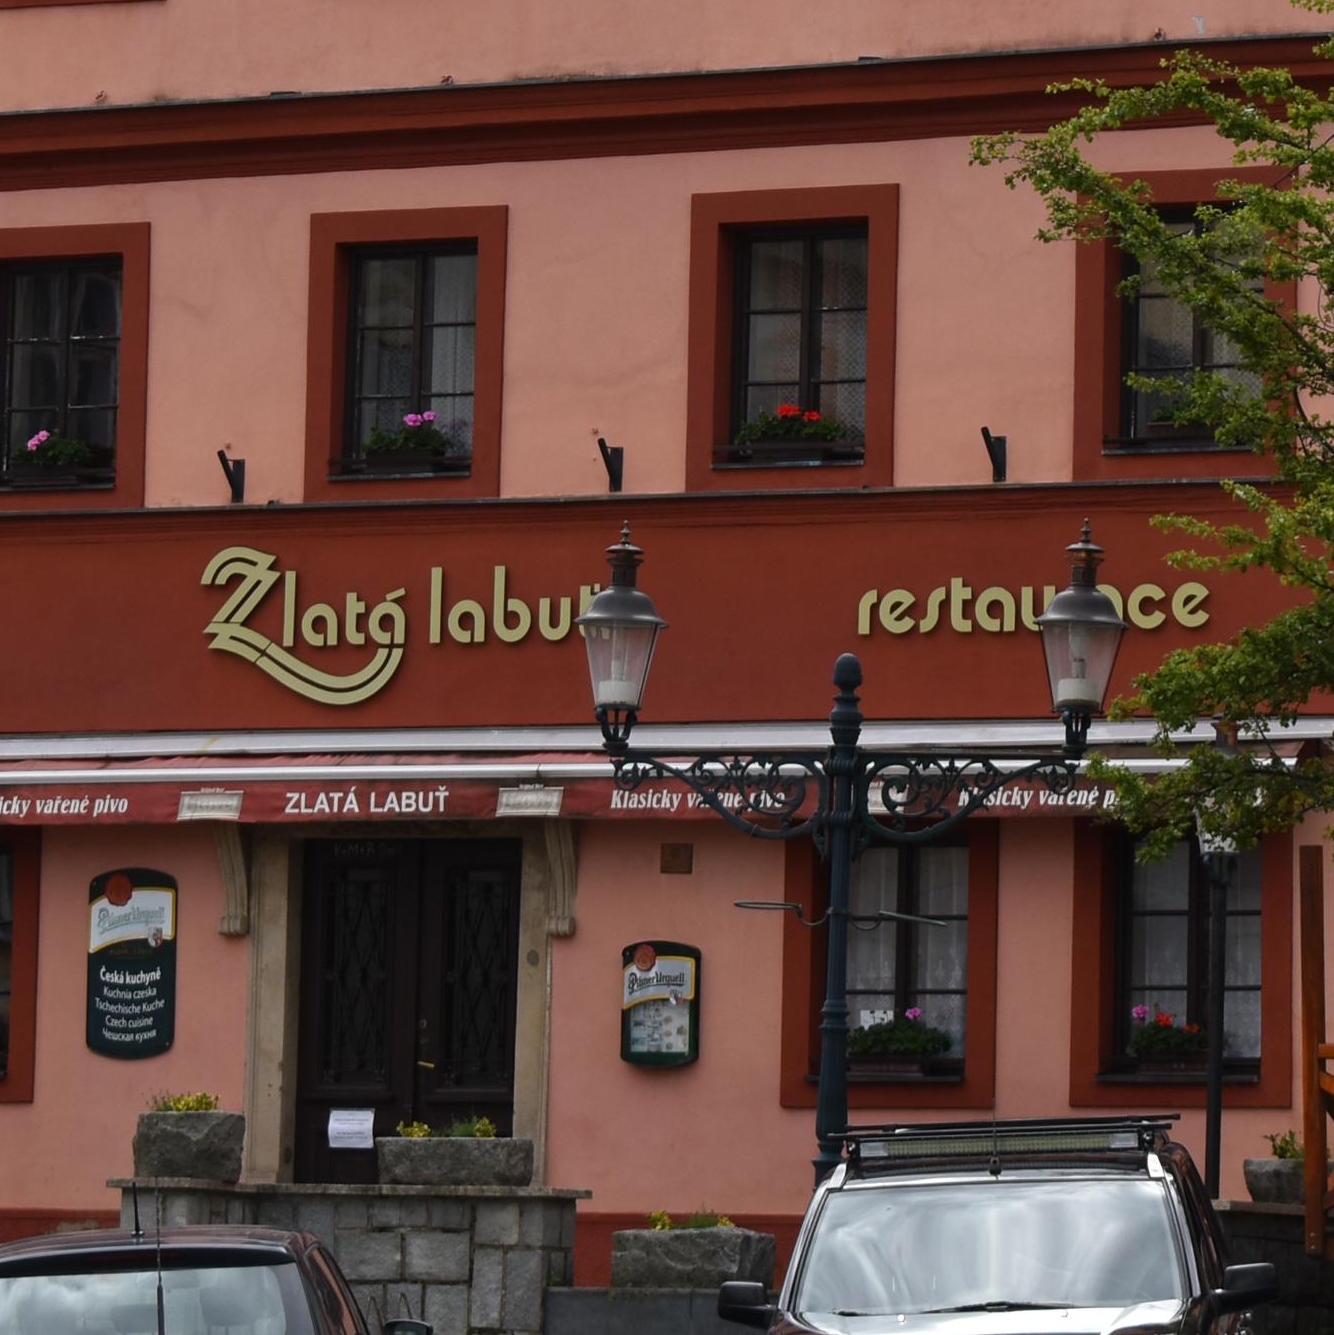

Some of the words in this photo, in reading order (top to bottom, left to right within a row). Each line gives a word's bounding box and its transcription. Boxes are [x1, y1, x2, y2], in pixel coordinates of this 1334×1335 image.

[857, 576, 1210, 635] restauce
[200, 545, 406, 706] Zlatá
[34, 793, 89, 814] vařené
[93, 794, 128, 818] pivo
[284, 787, 359, 814] ZLATÁ
[369, 785, 449, 813] LABUŤ
[611, 788, 682, 812] Klasicky
[100, 965, 124, 984] Česká
[125, 966, 162, 986] kuchyně
[655, 971, 685, 987] Urquell
[103, 985, 132, 999] Kuchnia
[133, 986, 157, 999] czeska
[95, 997, 141, 1014] Tschechische
[105, 1015, 127, 1028] Czech
[128, 1016, 154, 1028] cuisine
[102, 1027, 134, 1041] Чешская
[134, 1029, 157, 1043] кухня
